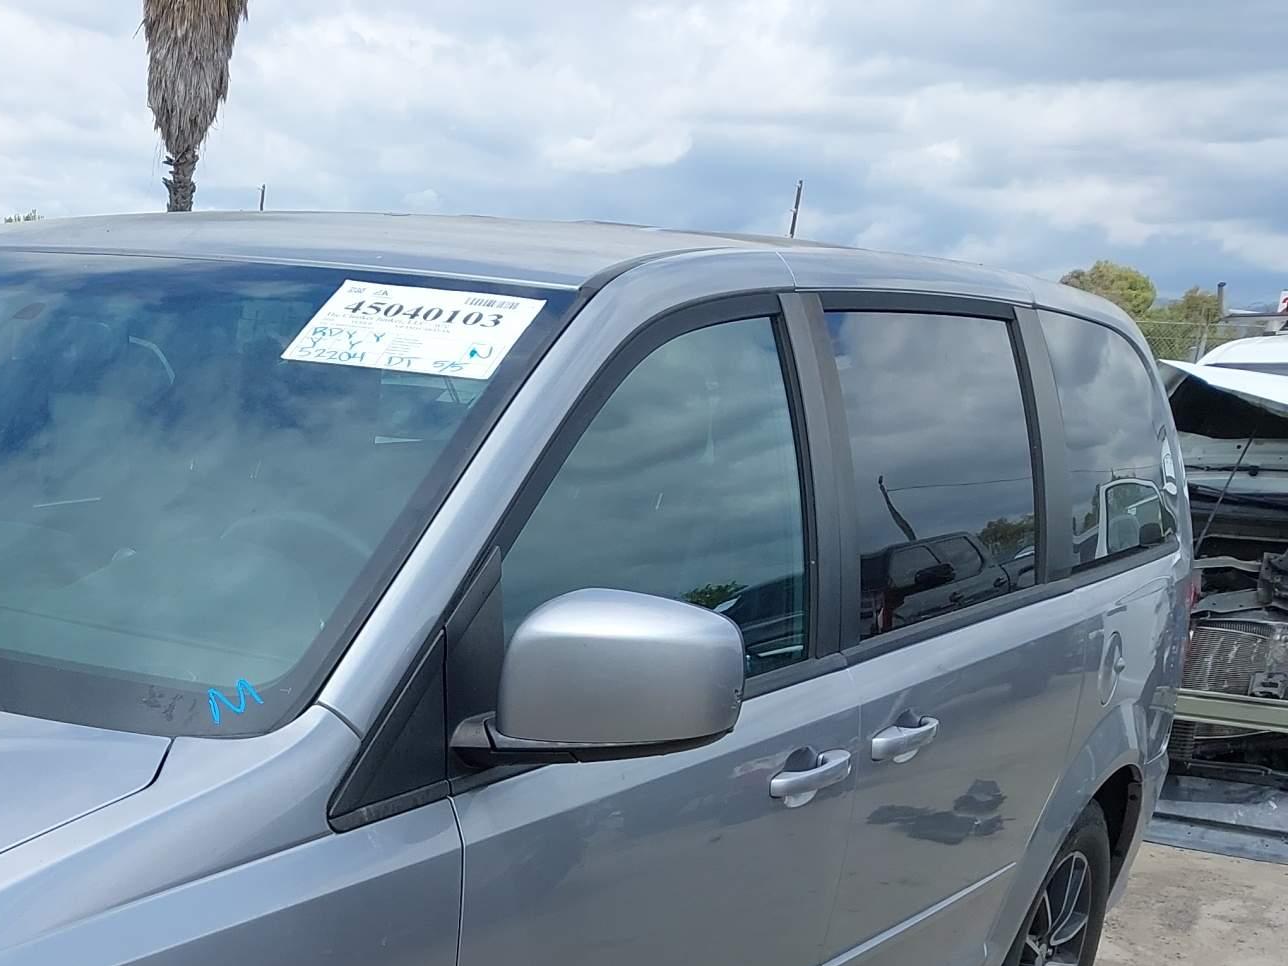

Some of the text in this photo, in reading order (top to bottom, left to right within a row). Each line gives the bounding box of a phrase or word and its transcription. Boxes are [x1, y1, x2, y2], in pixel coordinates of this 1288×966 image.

[344, 299, 504, 328] 45040103
[297, 346, 367, 362] 52204
[432, 360, 472, 373] 5/5
